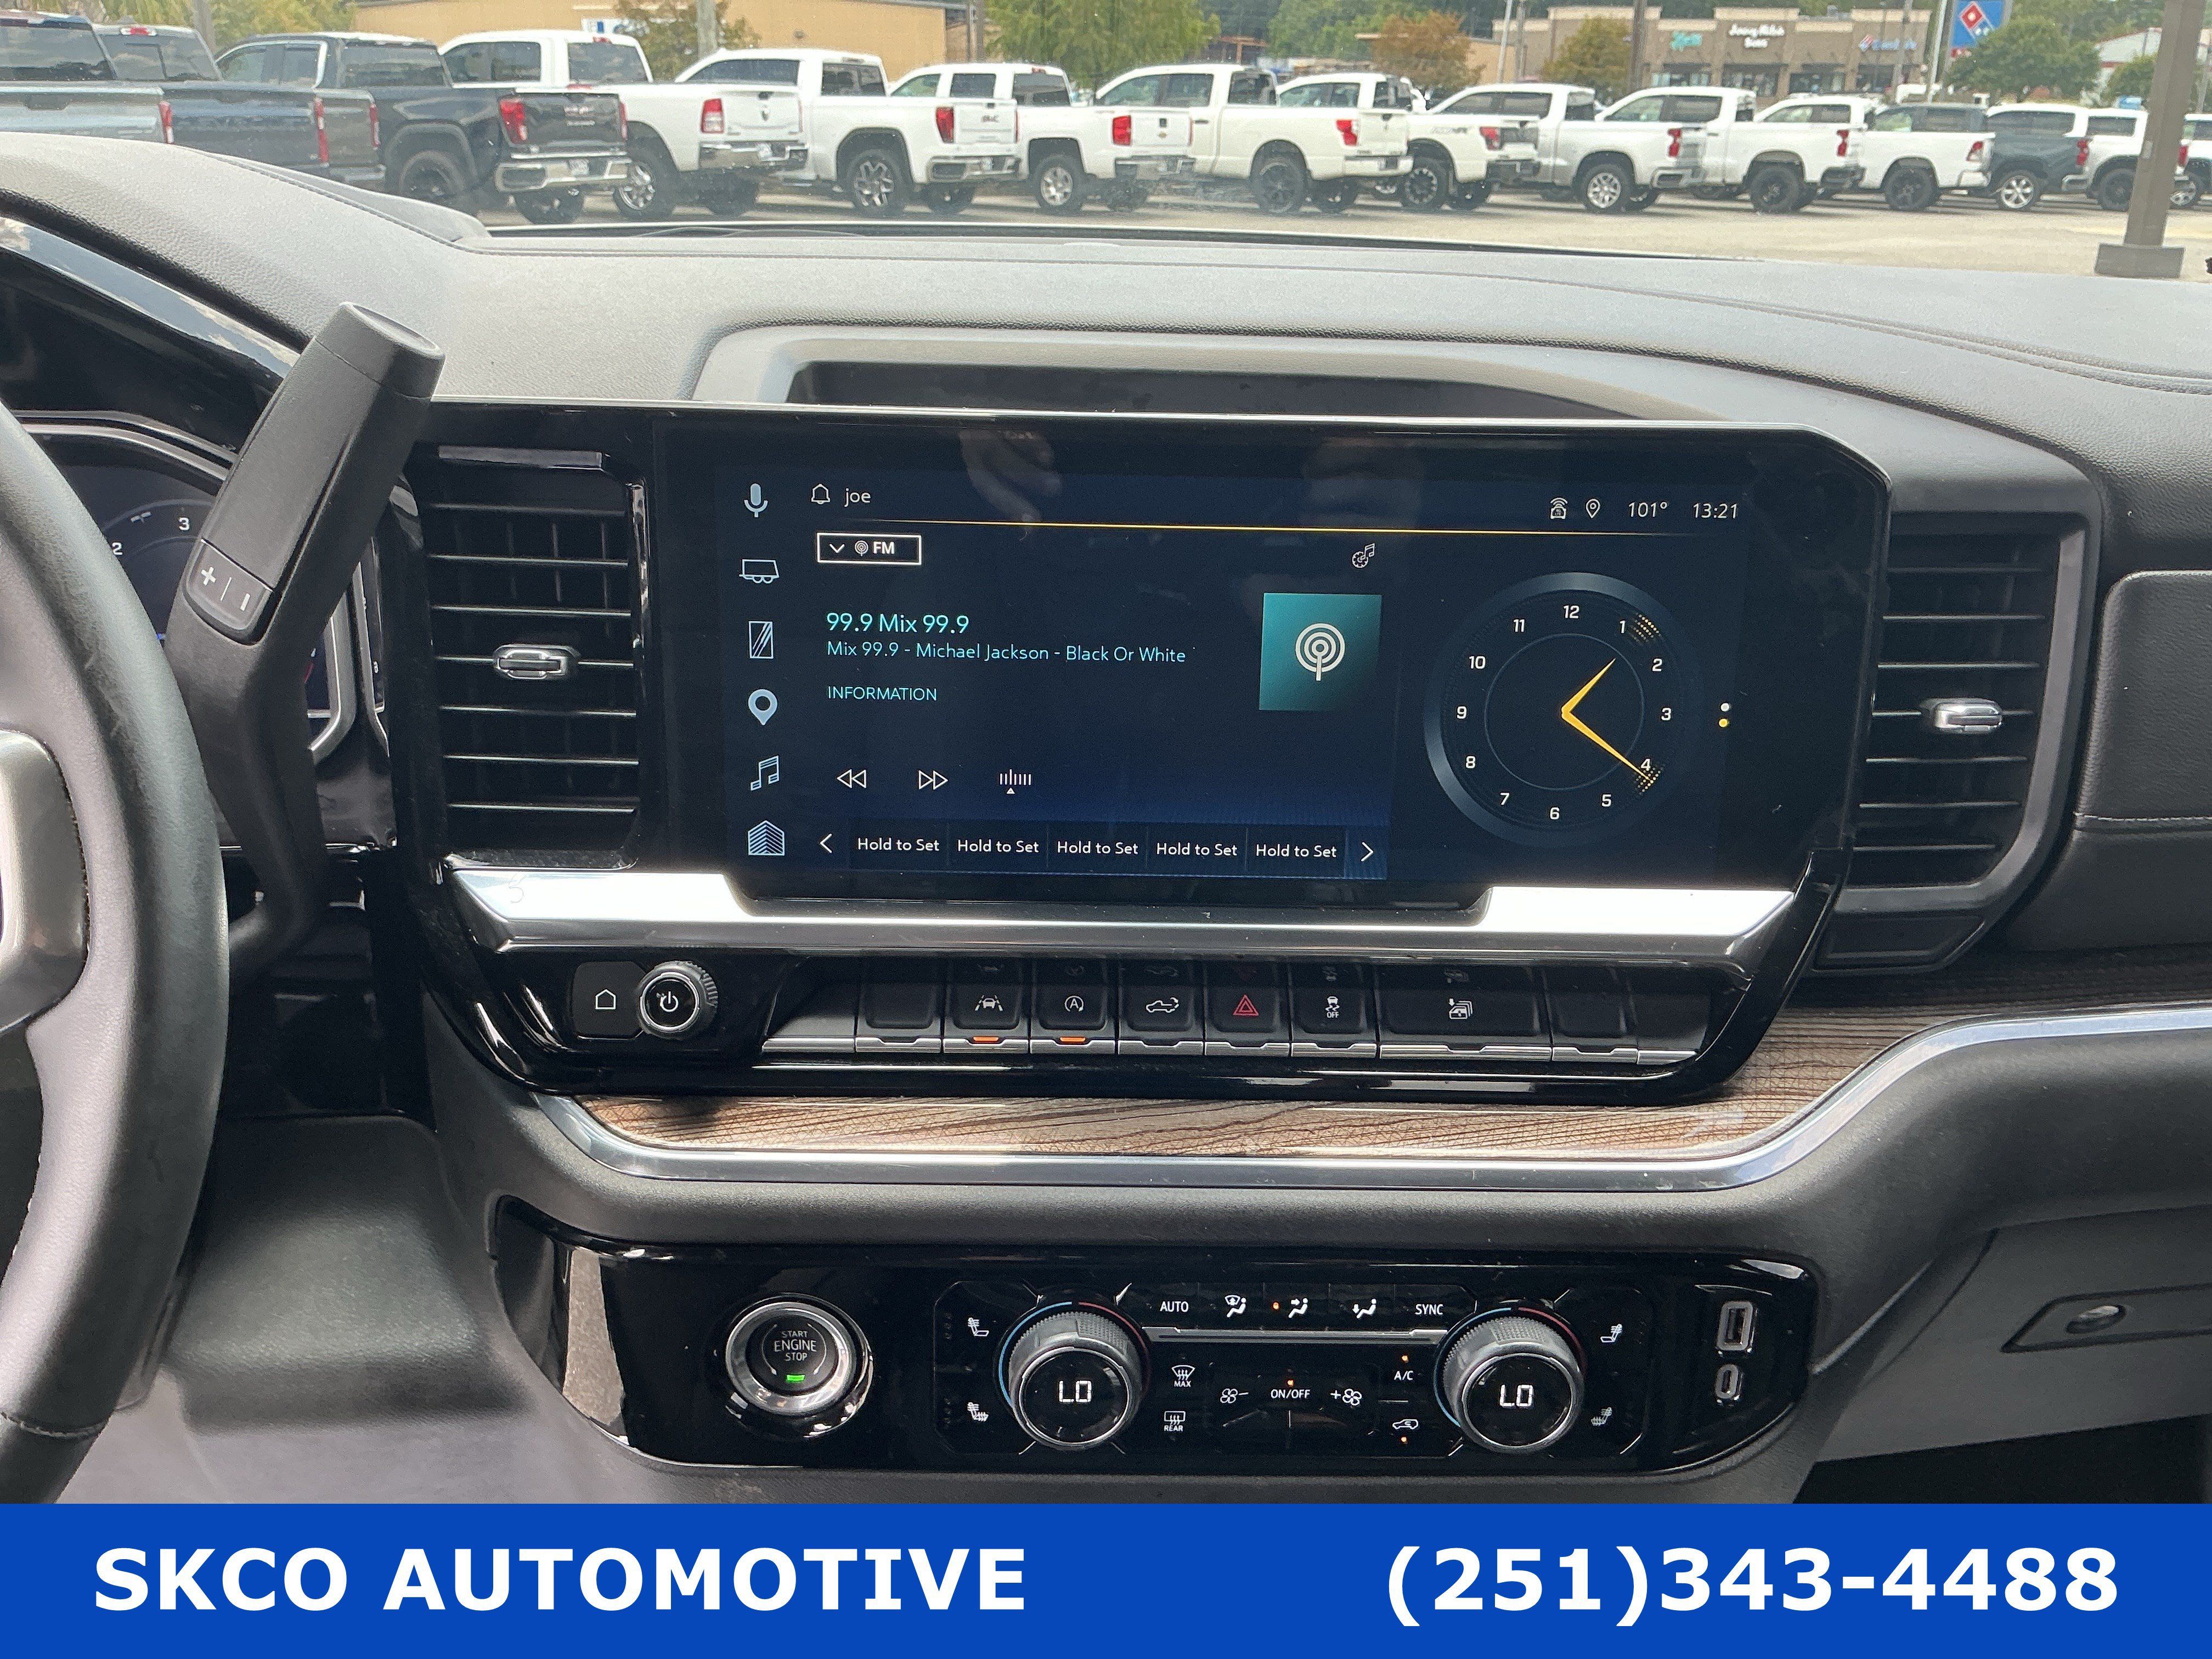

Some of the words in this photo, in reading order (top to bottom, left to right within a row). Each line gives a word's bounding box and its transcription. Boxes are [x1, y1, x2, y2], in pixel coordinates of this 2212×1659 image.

[844, 488, 871, 507] joe
[1629, 501, 1667, 517] 101°
[1693, 503, 1737, 518] 13:21
[179, 517, 190, 531] 3
[111, 541, 123, 556] 2
[873, 541, 895, 554] FM
[1564, 605, 1579, 619] 12
[827, 612, 873, 632] 99.9
[879, 613, 917, 633] Mix
[923, 614, 969, 634] 99.9
[1514, 619, 1525, 632] 11
[1620, 620, 1626, 634] 1
[827, 641, 857, 656] Mix
[862, 641, 899, 657] 99.9
[917, 642, 980, 658] Michael
[984, 644, 1048, 662] Jackson
[1066, 645, 1109, 661] Black
[1114, 646, 1134, 661] Or
[1139, 646, 1186, 662] White
[1469, 656, 1486, 669] 10
[1652, 658, 1662, 672] 2
[828, 686, 936, 701] INFORMATION
[1457, 706, 1467, 719] 9
[1661, 708, 1672, 721] 3
[1465, 755, 1476, 769] 8
[1640, 758, 1651, 771] 4
[1500, 792, 1510, 805] 7
[1601, 794, 1611, 807] 5
[1550, 807, 1560, 820] 6
[858, 837, 891, 850] Hold
[896, 839, 912, 851] to
[916, 839, 939, 851] Set
[958, 839, 991, 852] Hold
[996, 841, 1012, 853] to
[1015, 840, 1039, 853] Set
[1058, 840, 1091, 854] Hold
[1096, 843, 1111, 854] to
[1115, 842, 1138, 854] Set
[1156, 842, 1190, 855] Hold
[1195, 844, 1210, 855] to
[1214, 843, 1237, 856] Set
[1256, 844, 1290, 857] Hold
[1294, 846, 1309, 857] to
[1313, 845, 1337, 857] Set
[1160, 1301, 1189, 1312] AUTO
[1415, 1304, 1443, 1315] SYNC
[781, 1330, 808, 1339] START
[774, 1339, 817, 1352] ENGINE
[785, 1352, 808, 1362] STOP
[1394, 1370, 1413, 1380] A/C
[1059, 1380, 1092, 1403] LO
[1271, 1389, 1311, 1398] ON/OFF
[1499, 1384, 1533, 1407] LO
